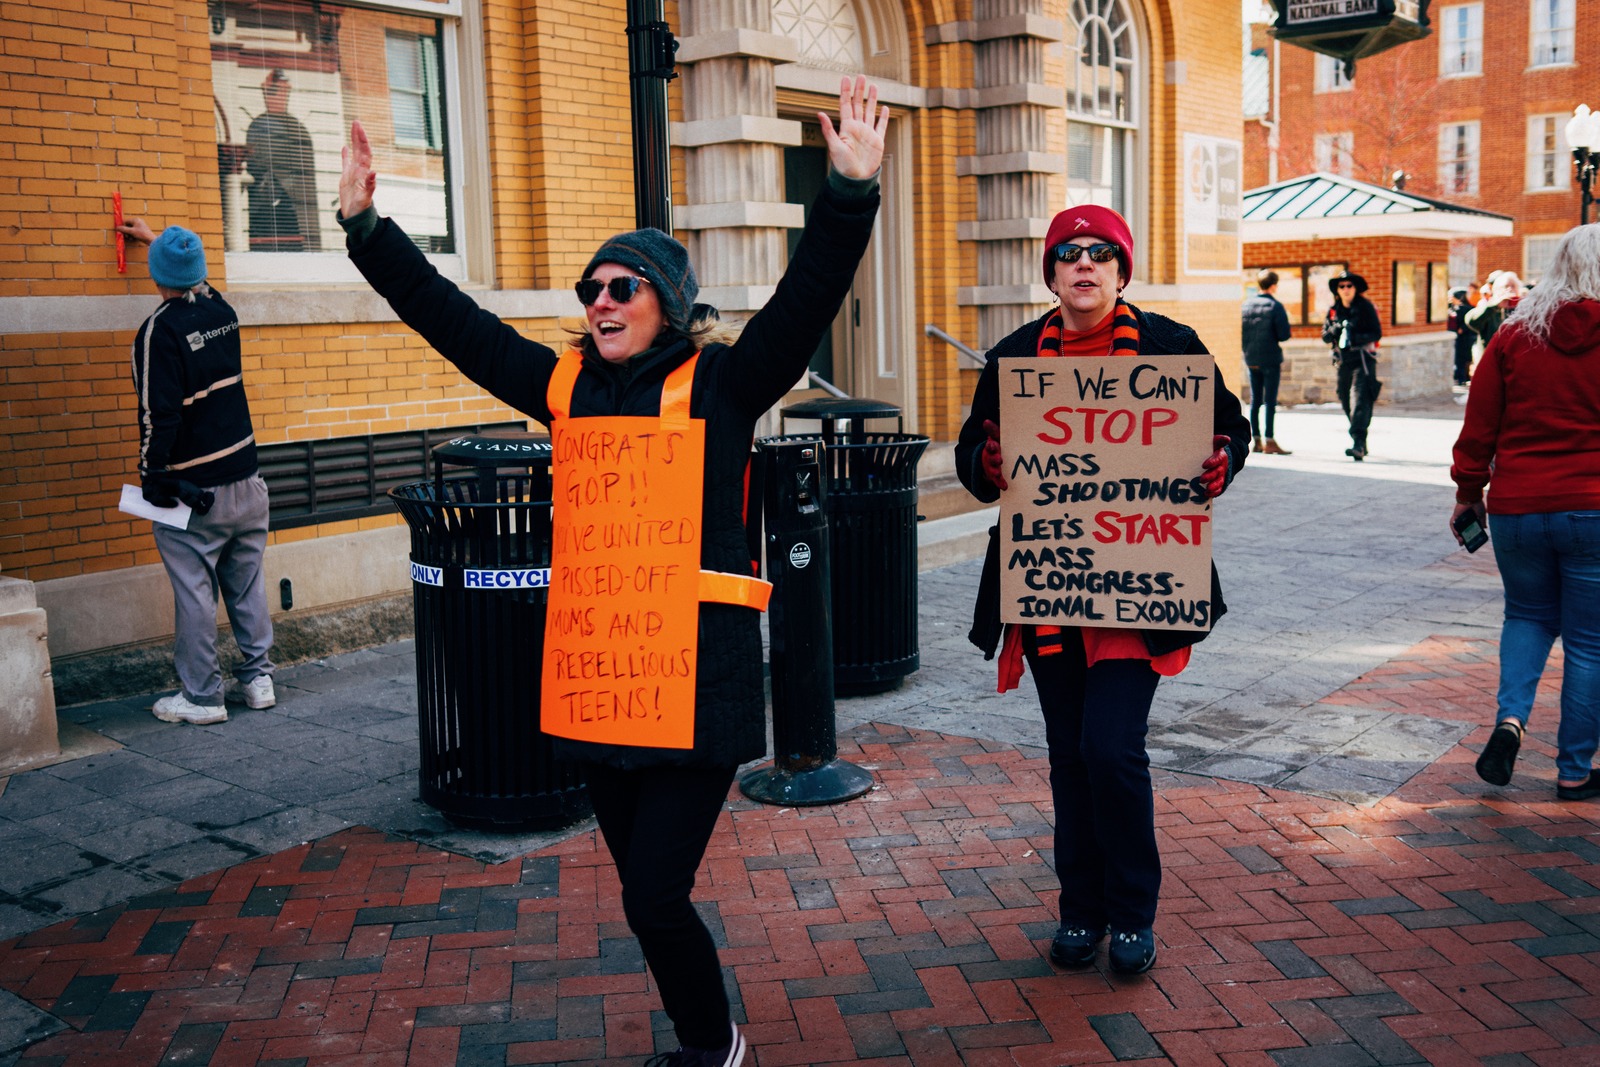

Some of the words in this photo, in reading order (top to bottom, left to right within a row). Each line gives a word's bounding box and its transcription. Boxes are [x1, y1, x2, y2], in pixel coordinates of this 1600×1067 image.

[188, 321, 238, 346] enterpris
[1010, 368, 1055, 399] IF
[1073, 366, 1120, 402] WE
[1129, 363, 1208, 403] CAN'T
[1035, 406, 1179, 446] STOP
[556, 428, 683, 471] CONGRATS
[1010, 453, 1101, 480] MASS
[1011, 512, 1083, 542] LET'S
[1091, 510, 1209, 546] START
[1008, 546, 1095, 570] MASS
[411, 567, 441, 585] ONLY
[562, 564, 679, 597] PISSED-OFF
[1024, 568, 1185, 596] CONGRESS-
[550, 607, 596, 638] MOMS
[608, 610, 663, 639] AND
[1016, 595, 1104, 621] IONAL
[1115, 598, 1211, 627] EXODUS
[560, 685, 662, 725] TEENS!
